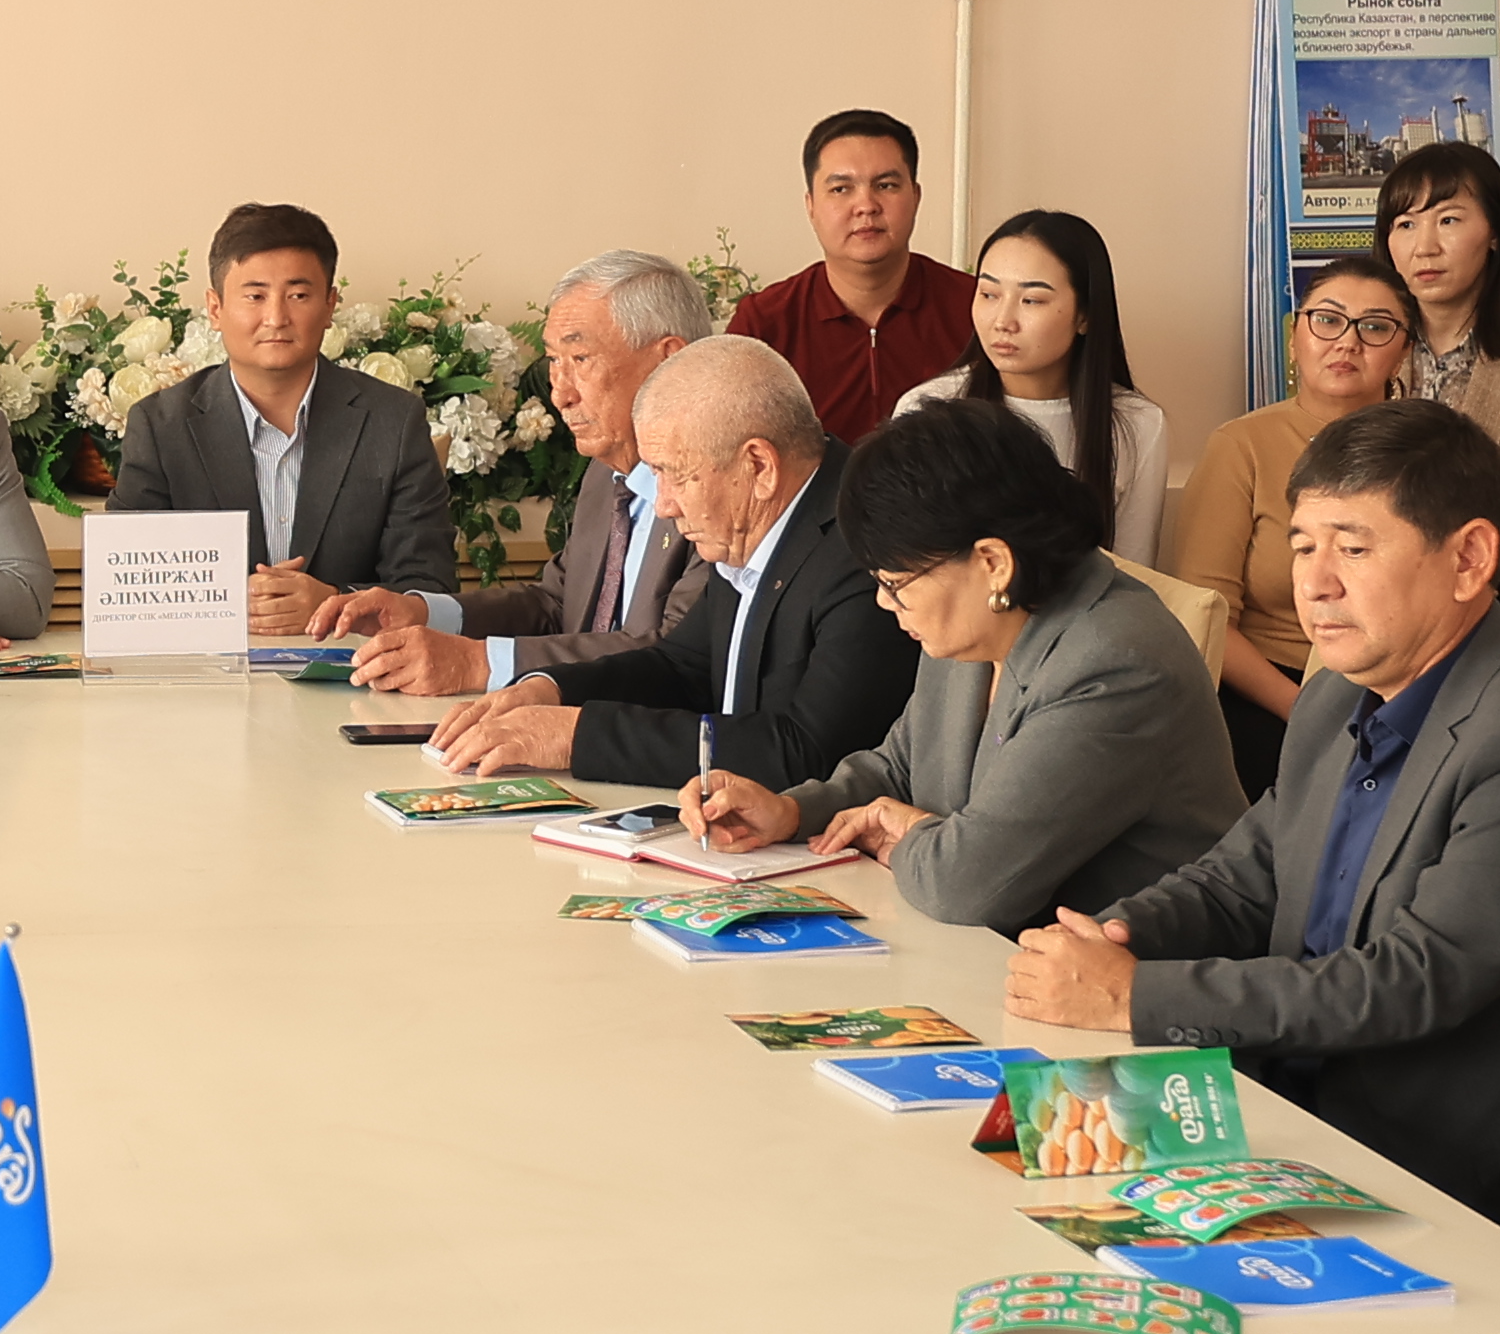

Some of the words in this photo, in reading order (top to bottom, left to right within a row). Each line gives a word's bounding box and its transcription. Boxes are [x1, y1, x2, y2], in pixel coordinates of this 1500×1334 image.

[1302, 193, 1352, 209] Автор:
[107, 550, 220, 566] ӘЛІМХАНОВ
[113, 568, 214, 585] МЕЙІРЖАН
[99, 589, 228, 606] ӘЛІМХАНҰЛЫ
[92, 613, 137, 623] ДИРЕКТОР
[138, 612, 157, 621] СПК
[158, 611, 193, 621] «MELON
[1160, 1073, 1207, 1144] Dara
